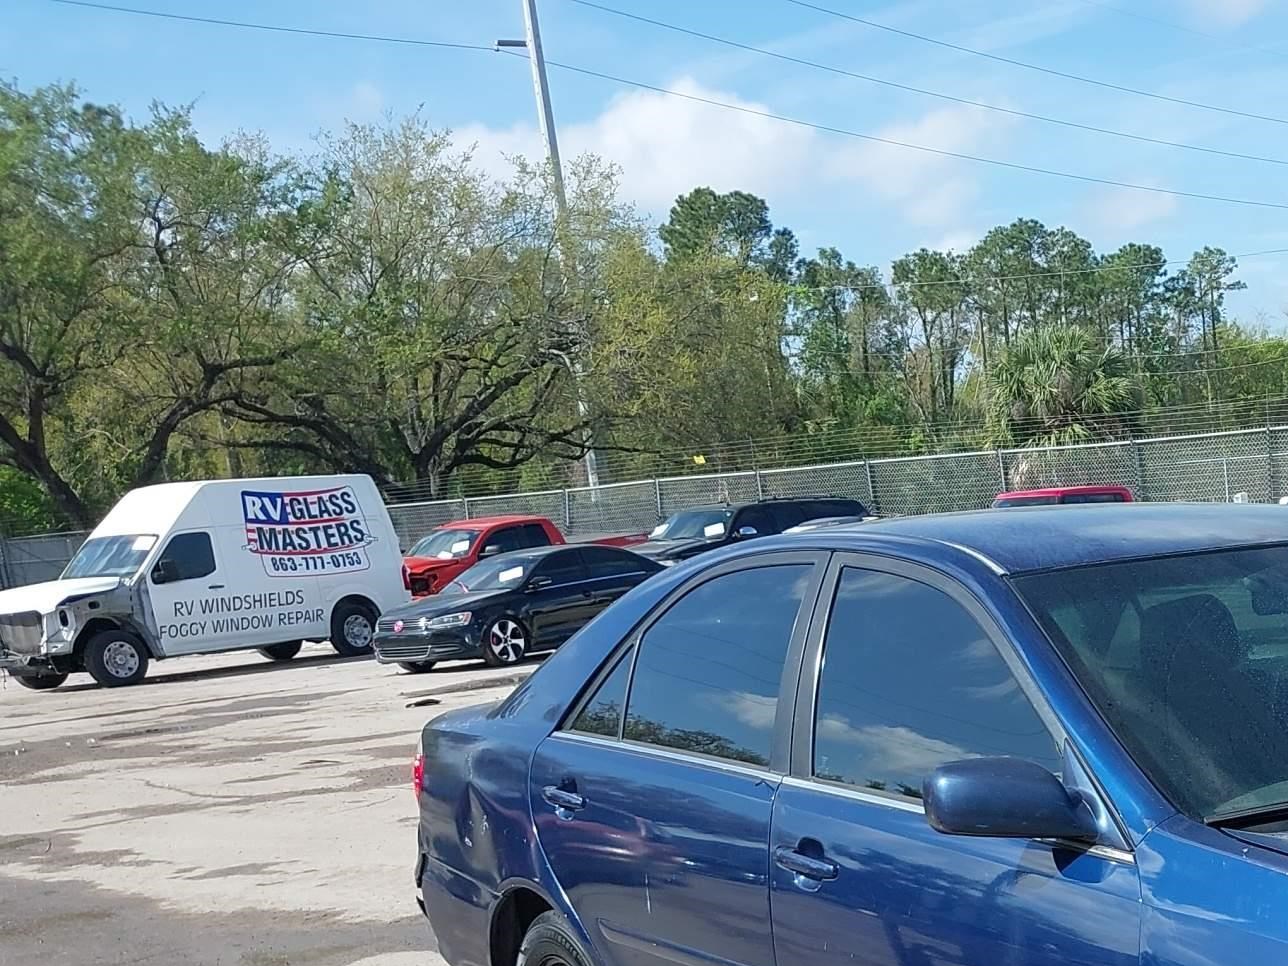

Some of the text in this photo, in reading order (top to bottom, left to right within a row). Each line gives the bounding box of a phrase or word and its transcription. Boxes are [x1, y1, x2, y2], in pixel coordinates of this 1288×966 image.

[244, 491, 356, 521] RV GLASS
[256, 519, 367, 551] MASTERS
[270, 551, 362, 572] 863-777-0753
[174, 590, 305, 617] RV WINDSHIELDS
[159, 608, 324, 639] FOGGY WINDOW REPAIR
